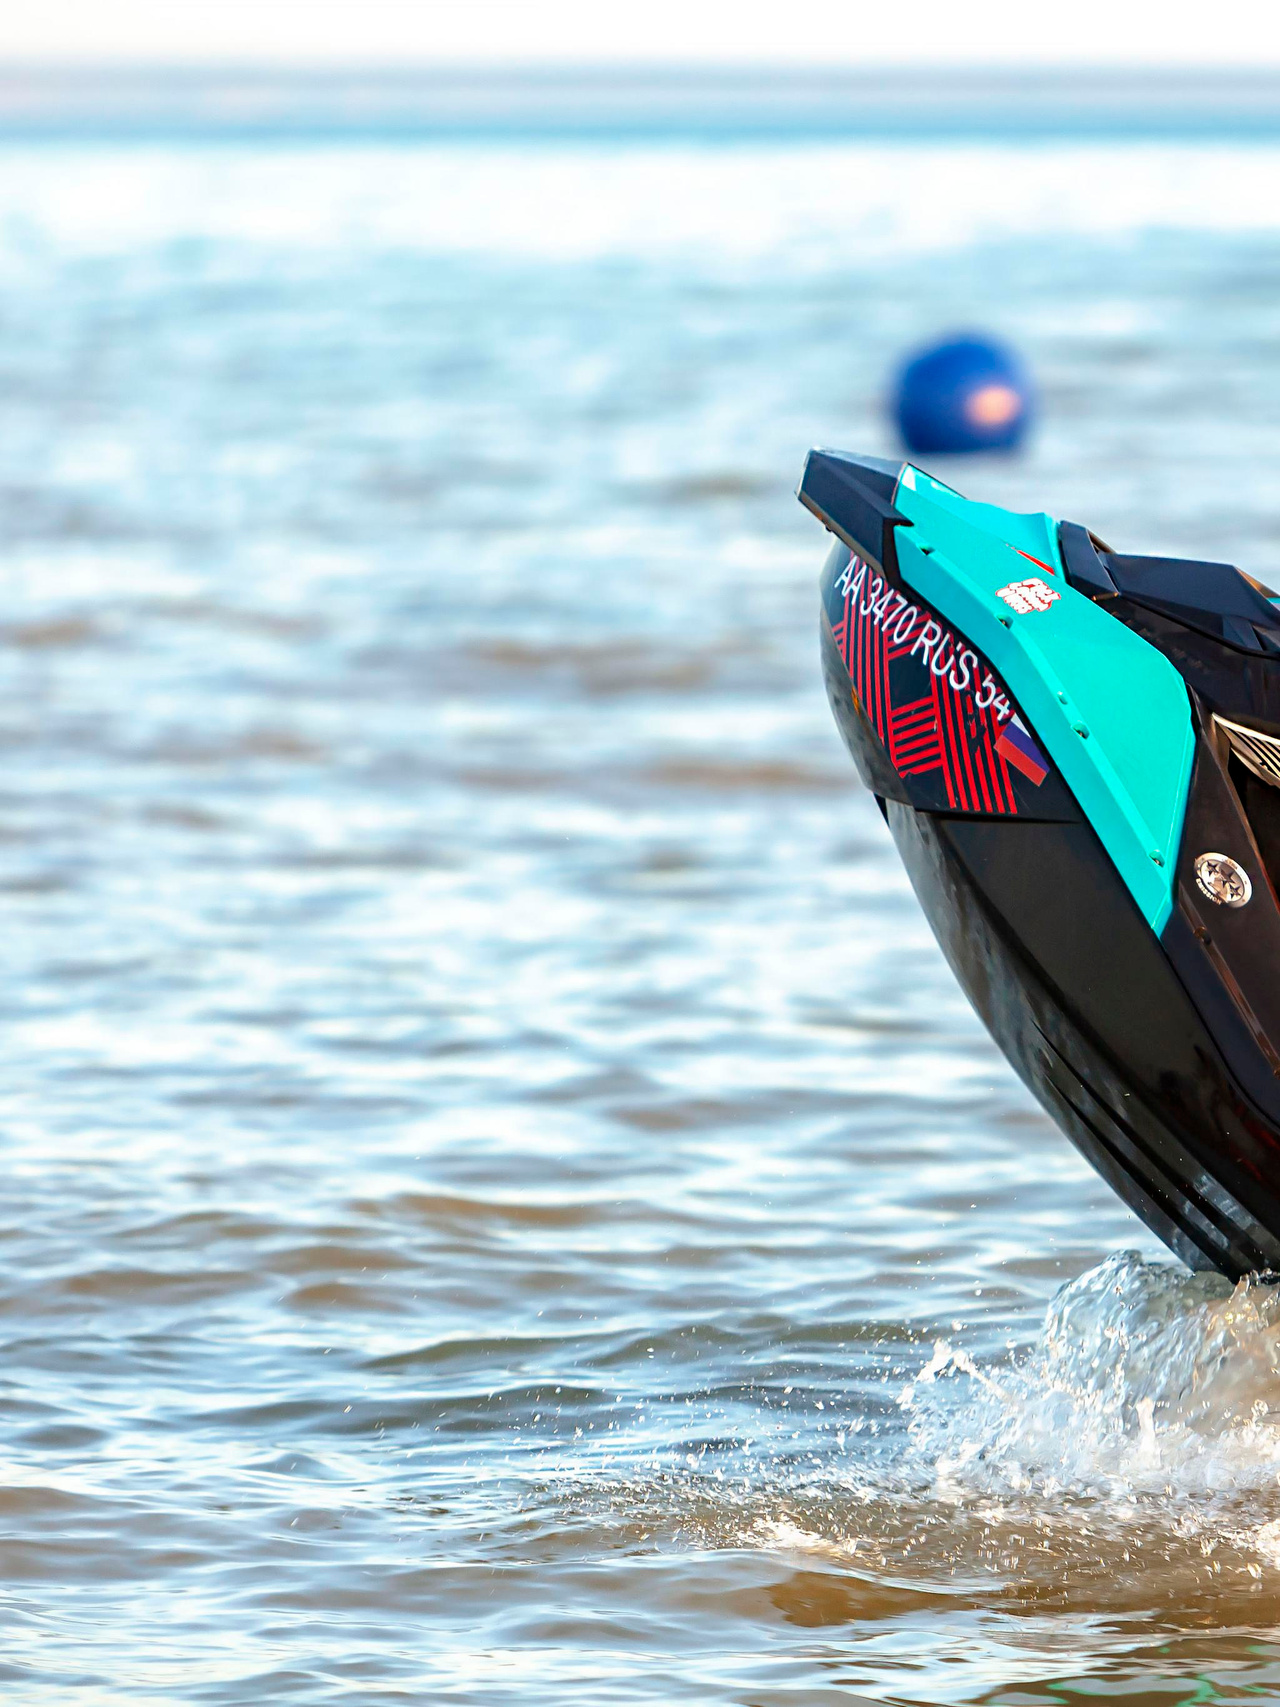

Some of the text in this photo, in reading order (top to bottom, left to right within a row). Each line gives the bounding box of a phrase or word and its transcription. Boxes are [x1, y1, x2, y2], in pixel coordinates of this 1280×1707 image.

[834, 555, 1011, 721] AA 3470 RUS 54
